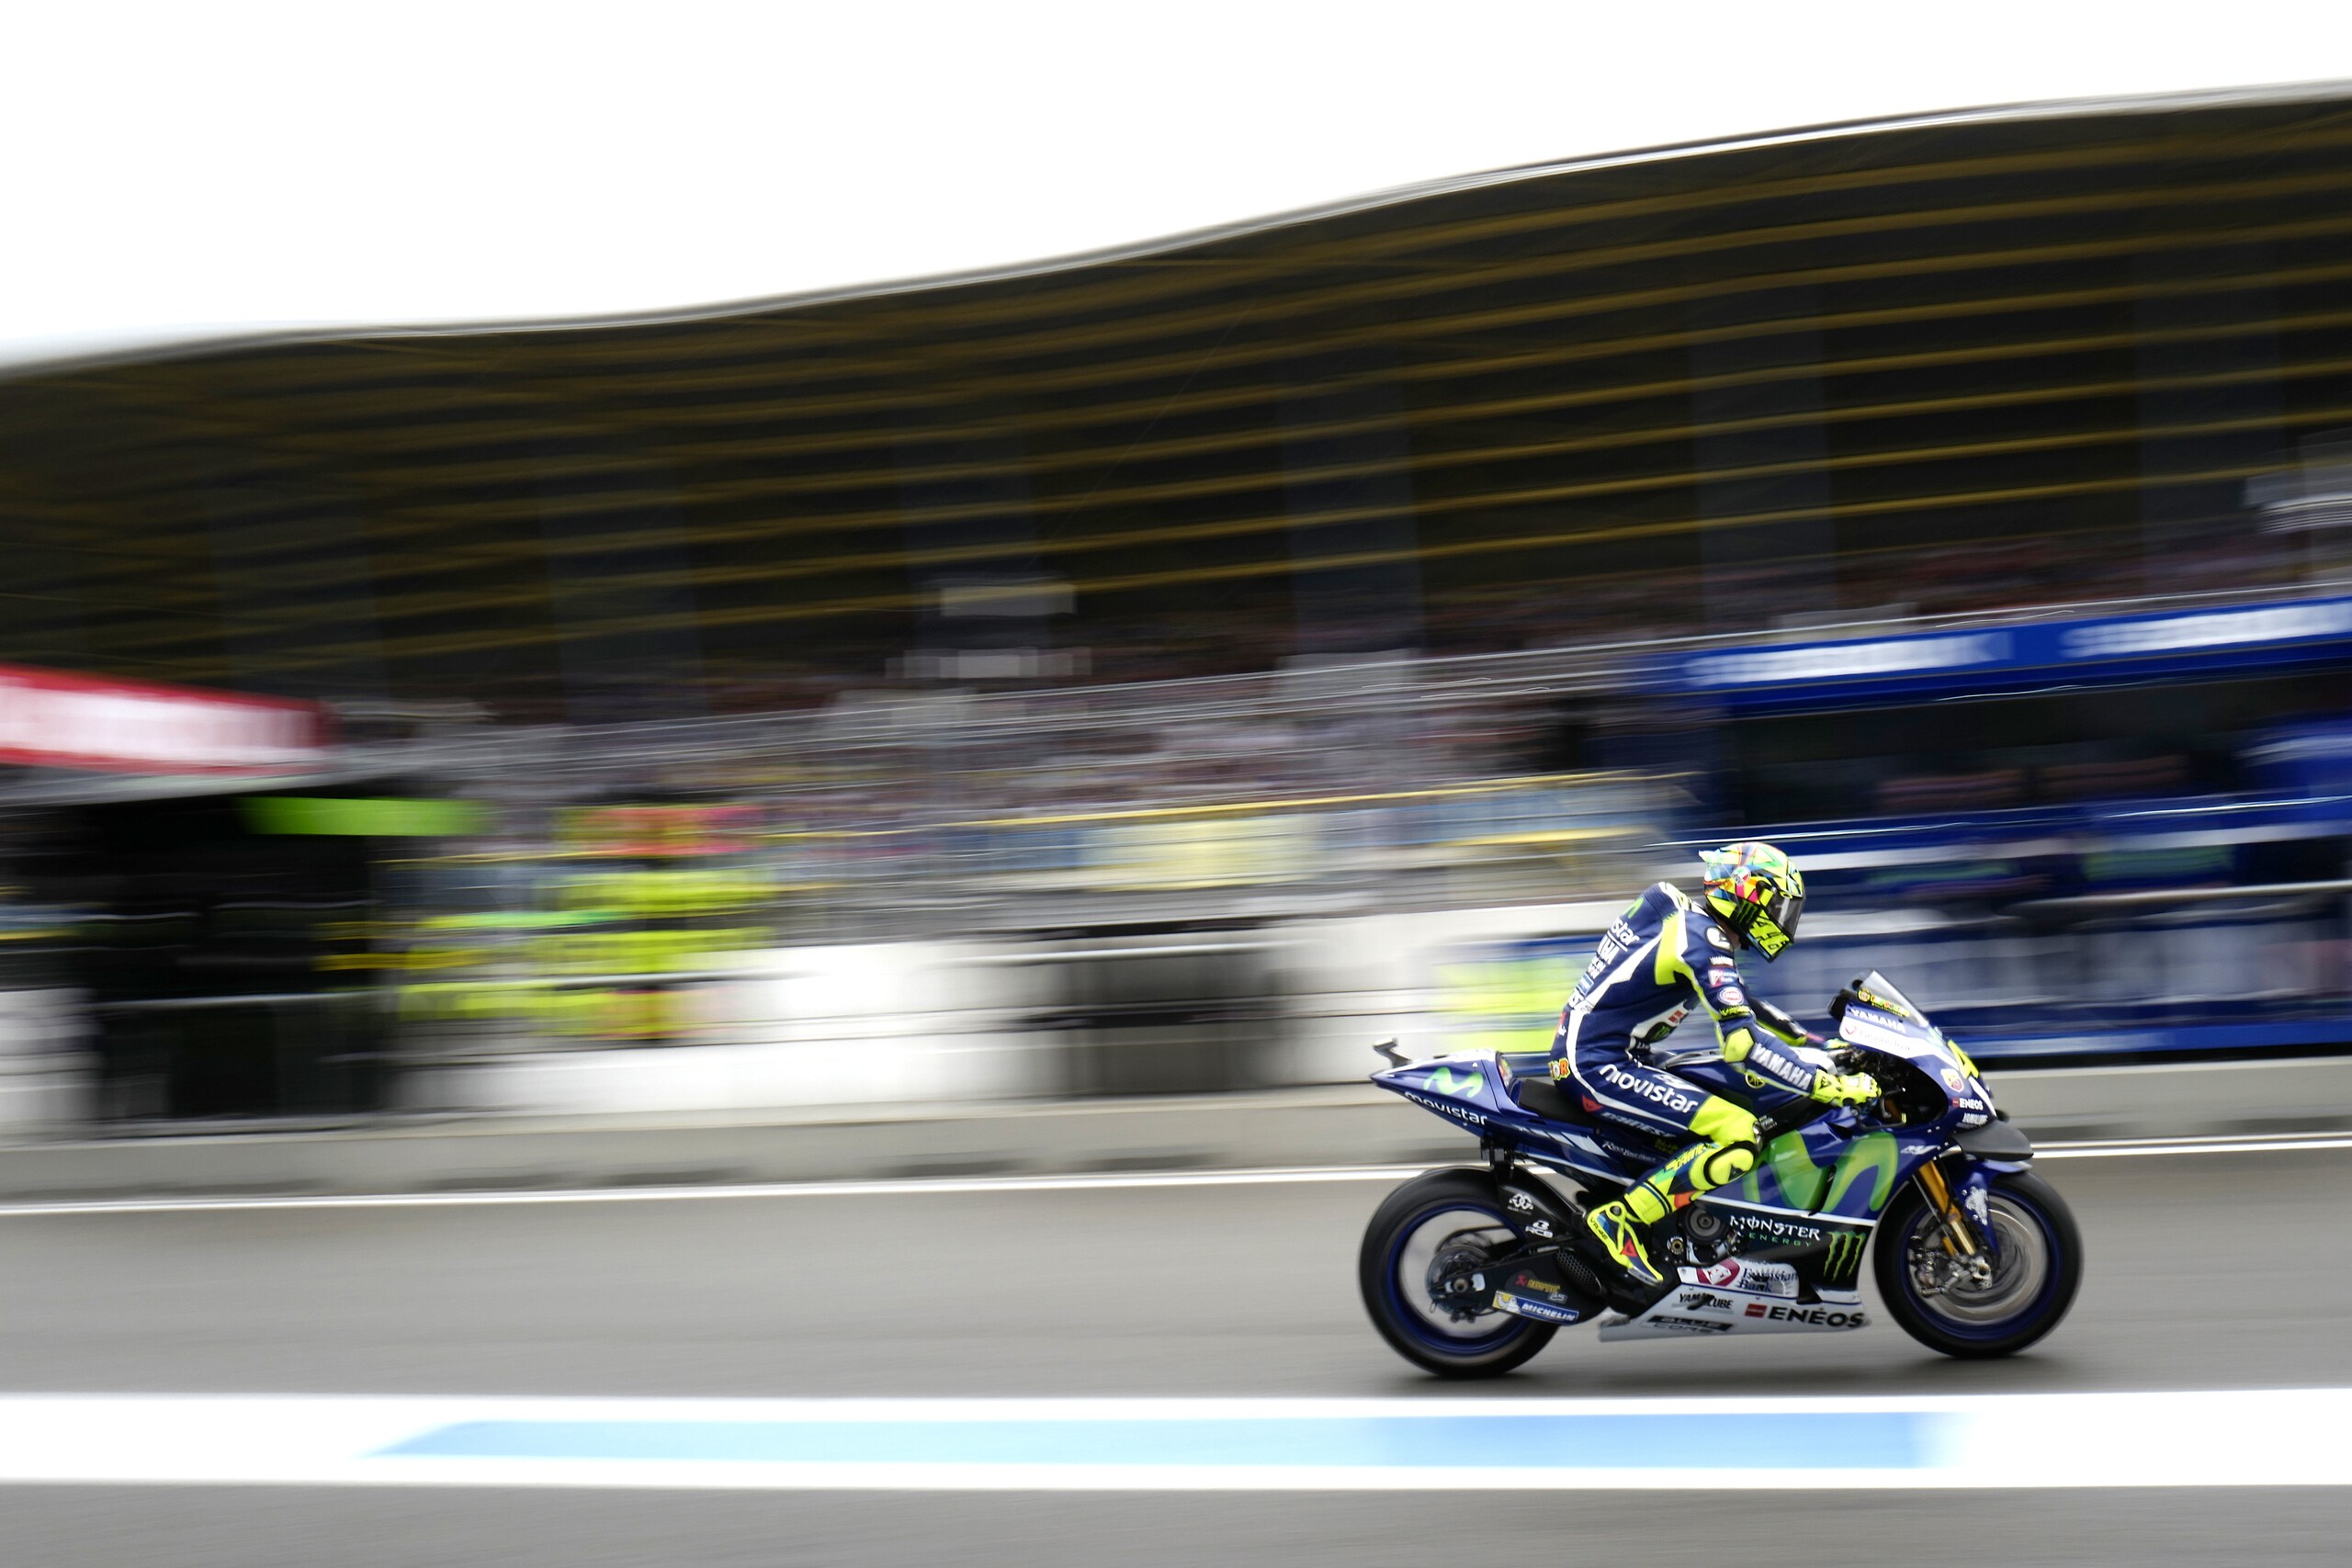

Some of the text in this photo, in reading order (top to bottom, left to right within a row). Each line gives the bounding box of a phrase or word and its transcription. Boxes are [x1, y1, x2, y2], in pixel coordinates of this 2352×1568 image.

[1748, 916, 1791, 956] 46
[1849, 1008, 1906, 1033] YAMAHA
[1749, 1043, 1813, 1090] YAMAHA
[1599, 1064, 1699, 1113] movistar
[1959, 1097, 1984, 1111] ENEOS
[1729, 1214, 1822, 1241] MONSTER
[1748, 1233, 1813, 1247] ENERGY
[1521, 1302, 1576, 1322] MICHELIN
[1768, 1306, 1866, 1328] ENEOS
